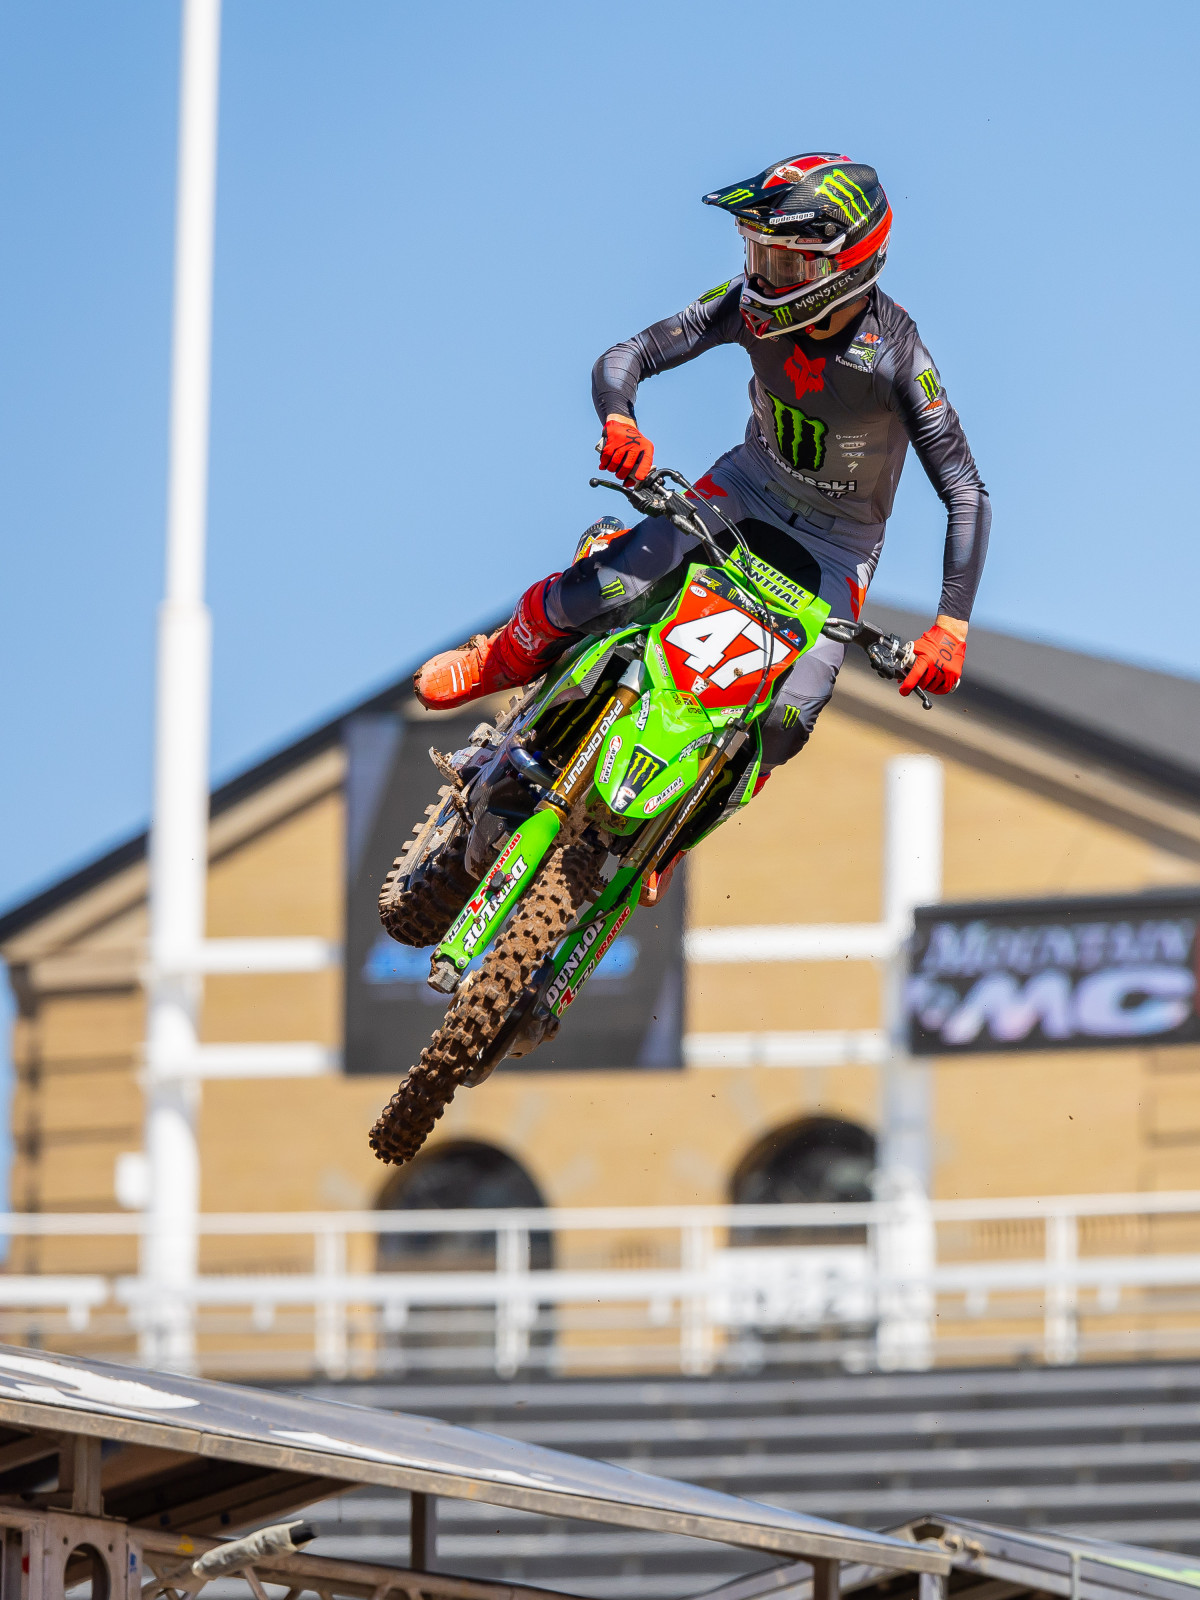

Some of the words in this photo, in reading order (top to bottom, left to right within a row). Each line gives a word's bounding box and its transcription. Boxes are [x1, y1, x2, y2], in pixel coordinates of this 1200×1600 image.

[795, 274, 854, 310] MONSTER
[835, 354, 874, 374] Kawasak
[663, 606, 793, 692] 47
[934, 636, 957, 675] FOX
[599, 699, 625, 736] PRO
[563, 732, 603, 795] CIRCUIT
[595, 905, 631, 962] BRAKING
